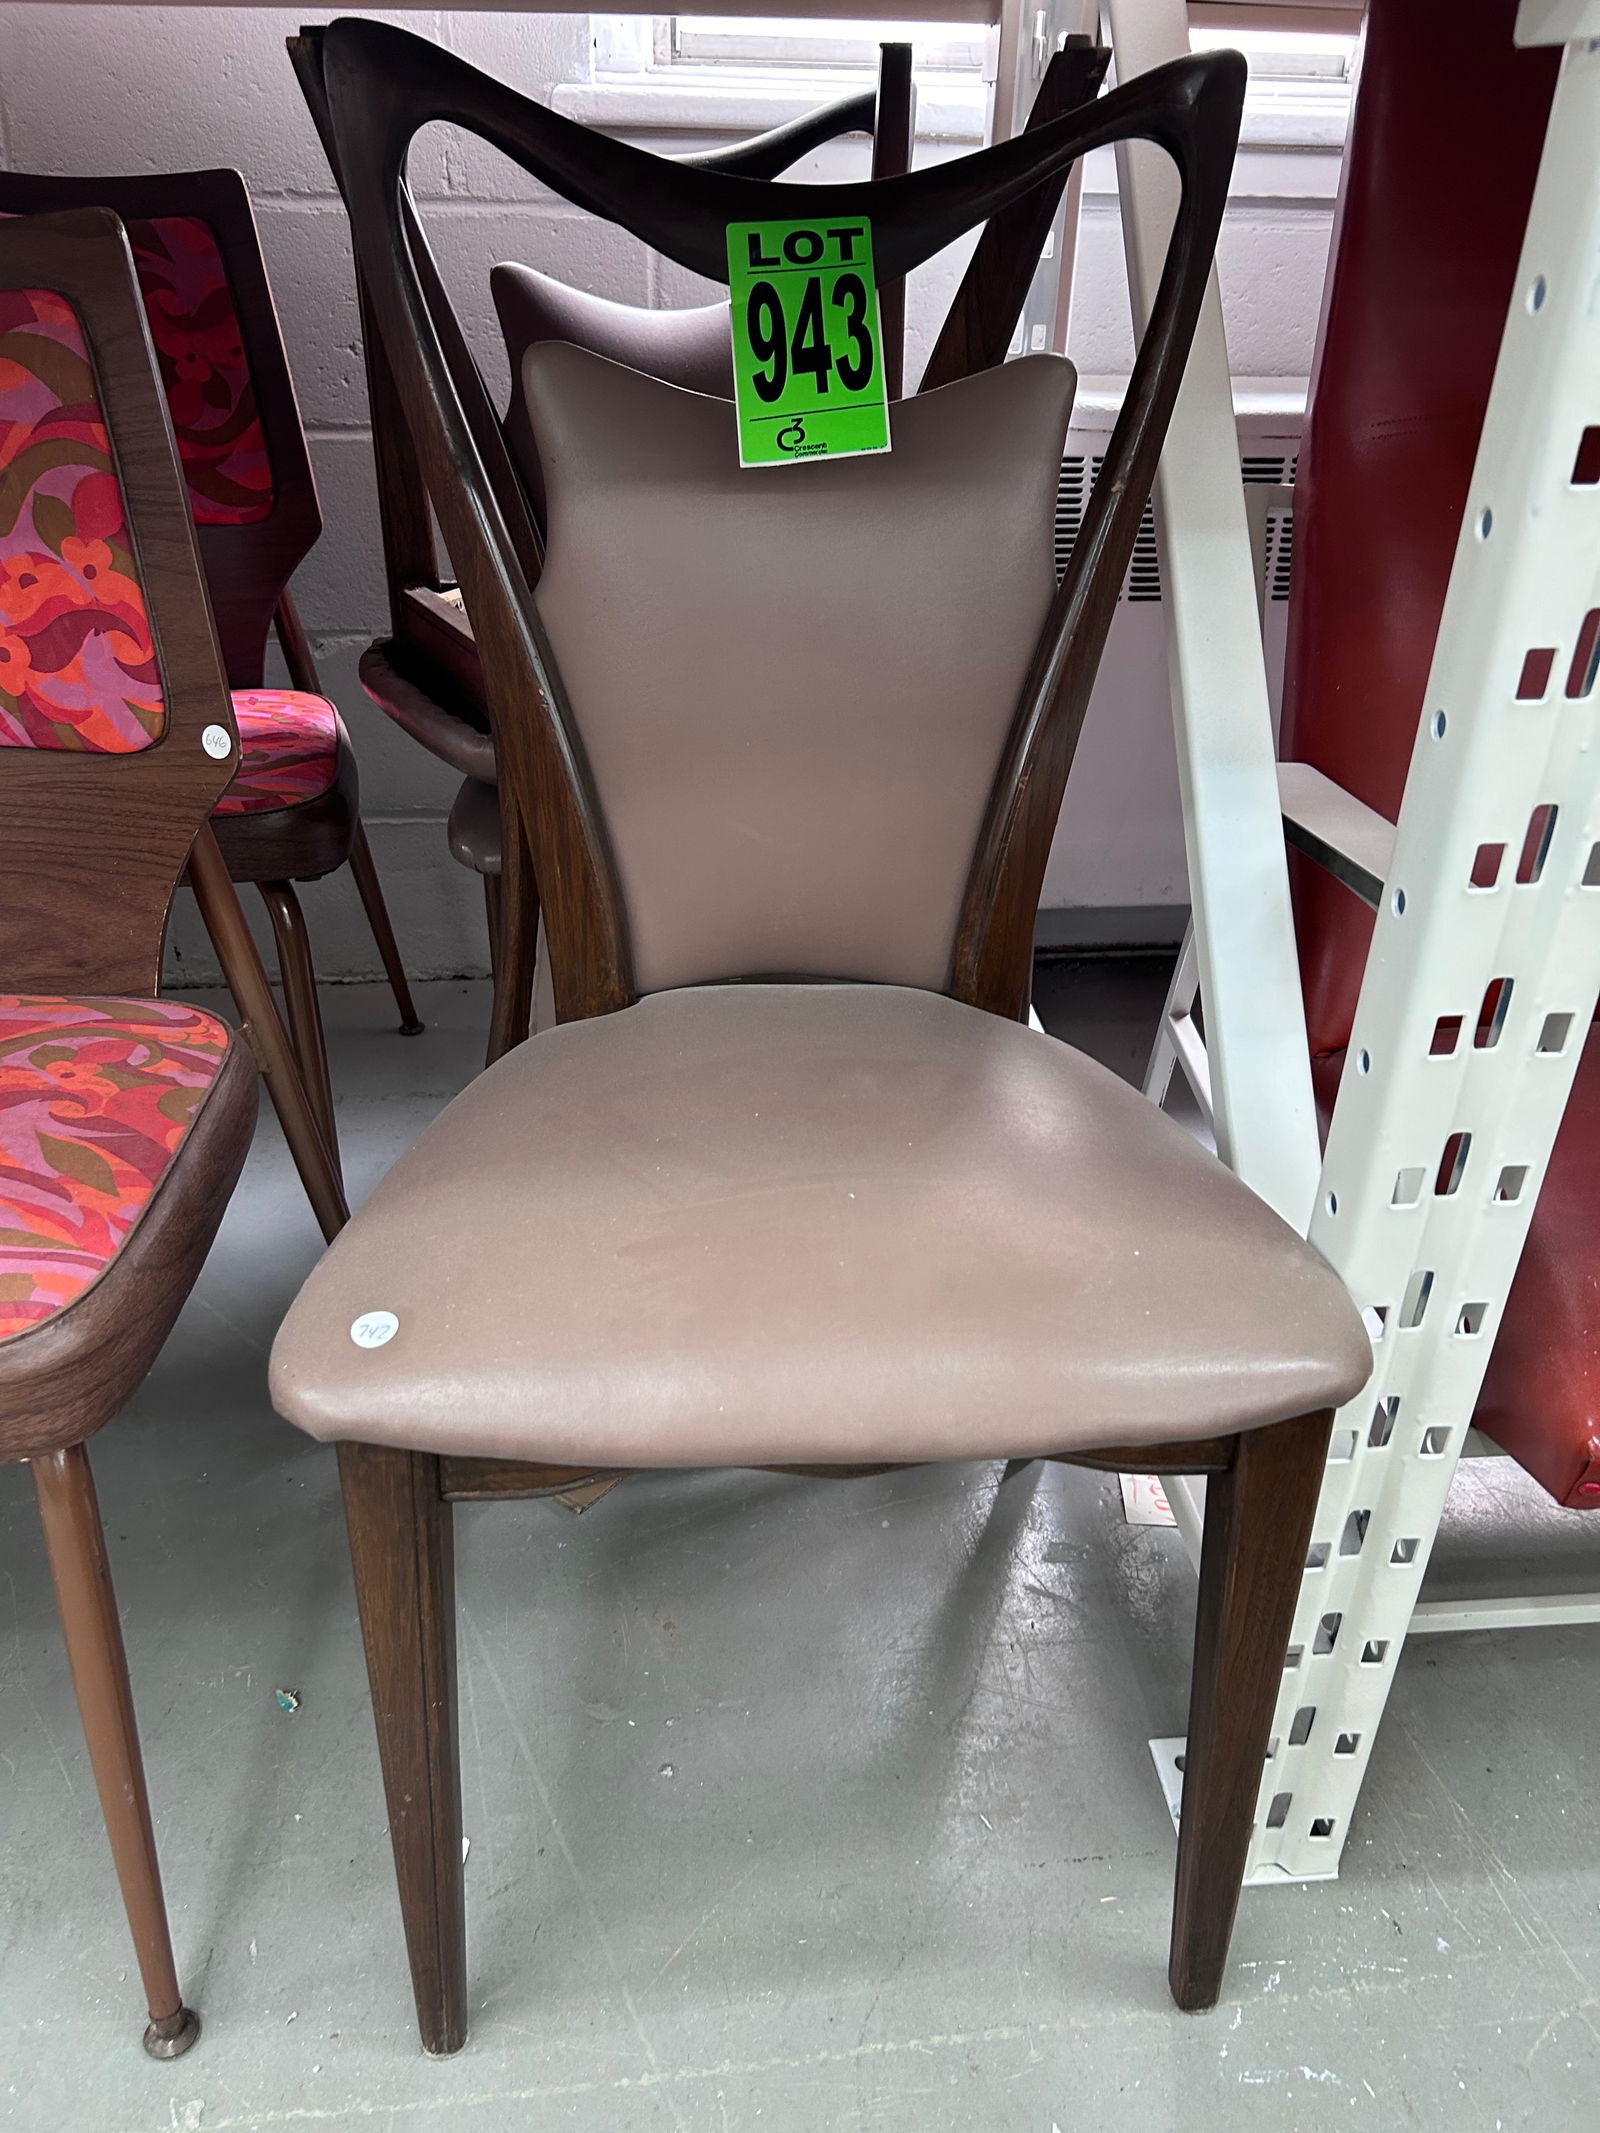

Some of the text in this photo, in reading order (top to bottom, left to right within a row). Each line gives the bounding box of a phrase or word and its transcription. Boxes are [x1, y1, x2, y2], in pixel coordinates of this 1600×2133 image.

[747, 227, 864, 267] LOT
[747, 273, 873, 403] 943
[794, 442, 827, 452] Crescent
[205, 733, 227, 748] 646
